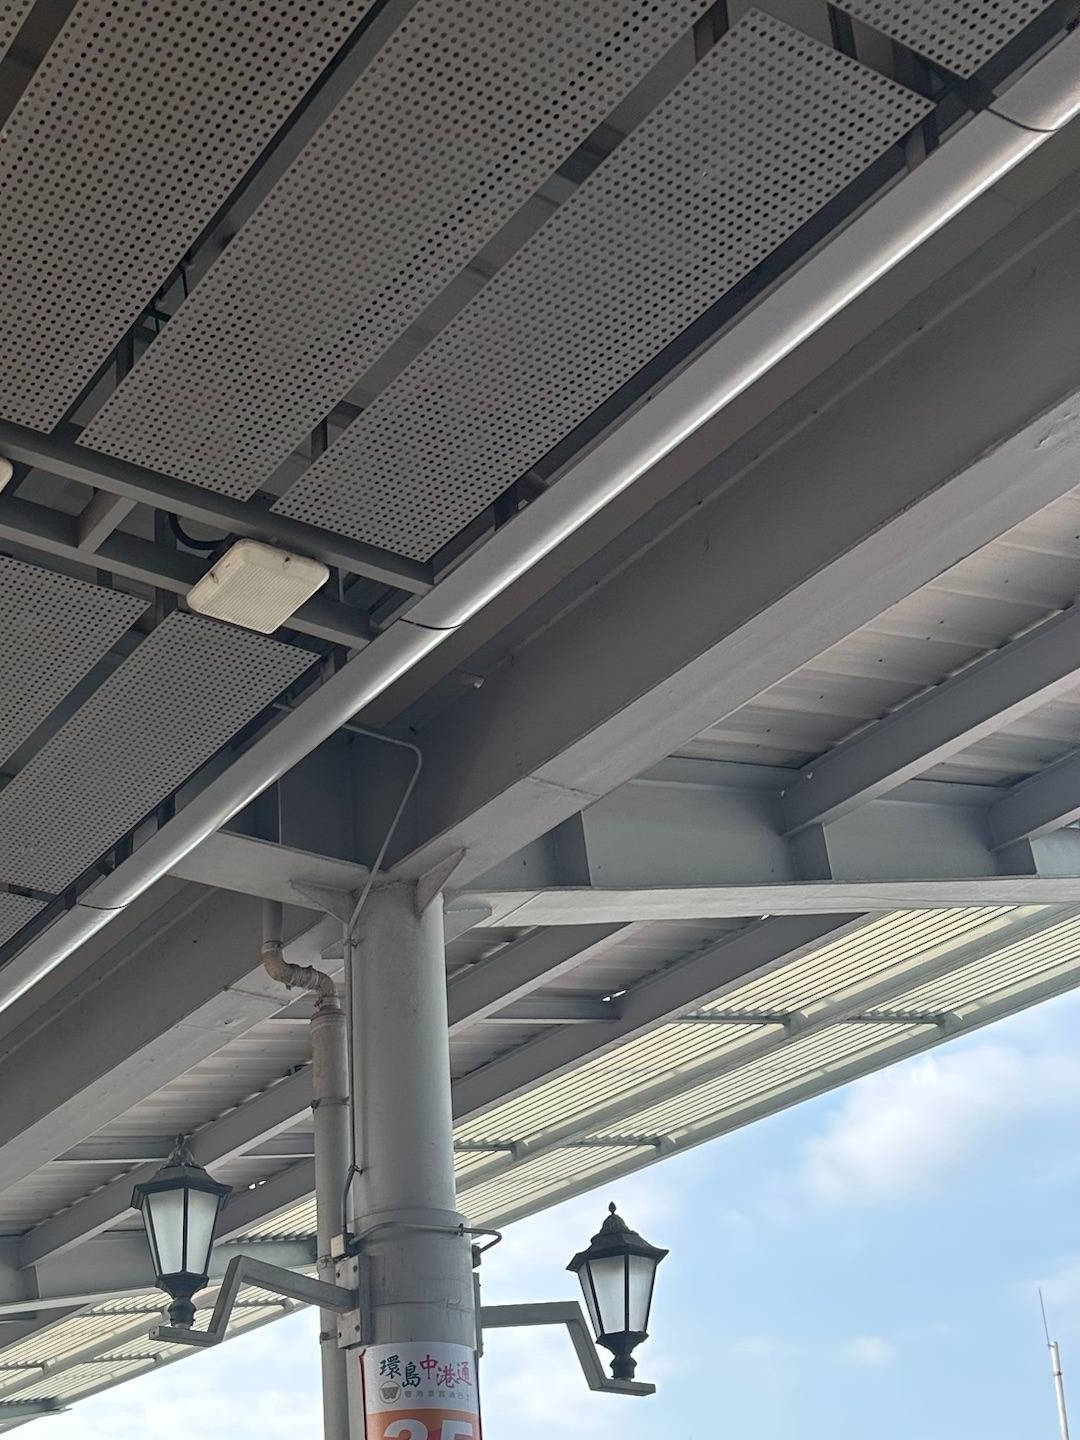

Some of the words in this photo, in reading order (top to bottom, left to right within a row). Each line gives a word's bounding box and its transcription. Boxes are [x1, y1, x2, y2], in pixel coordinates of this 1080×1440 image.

[379, 1354, 472, 1388] 環島中港通
